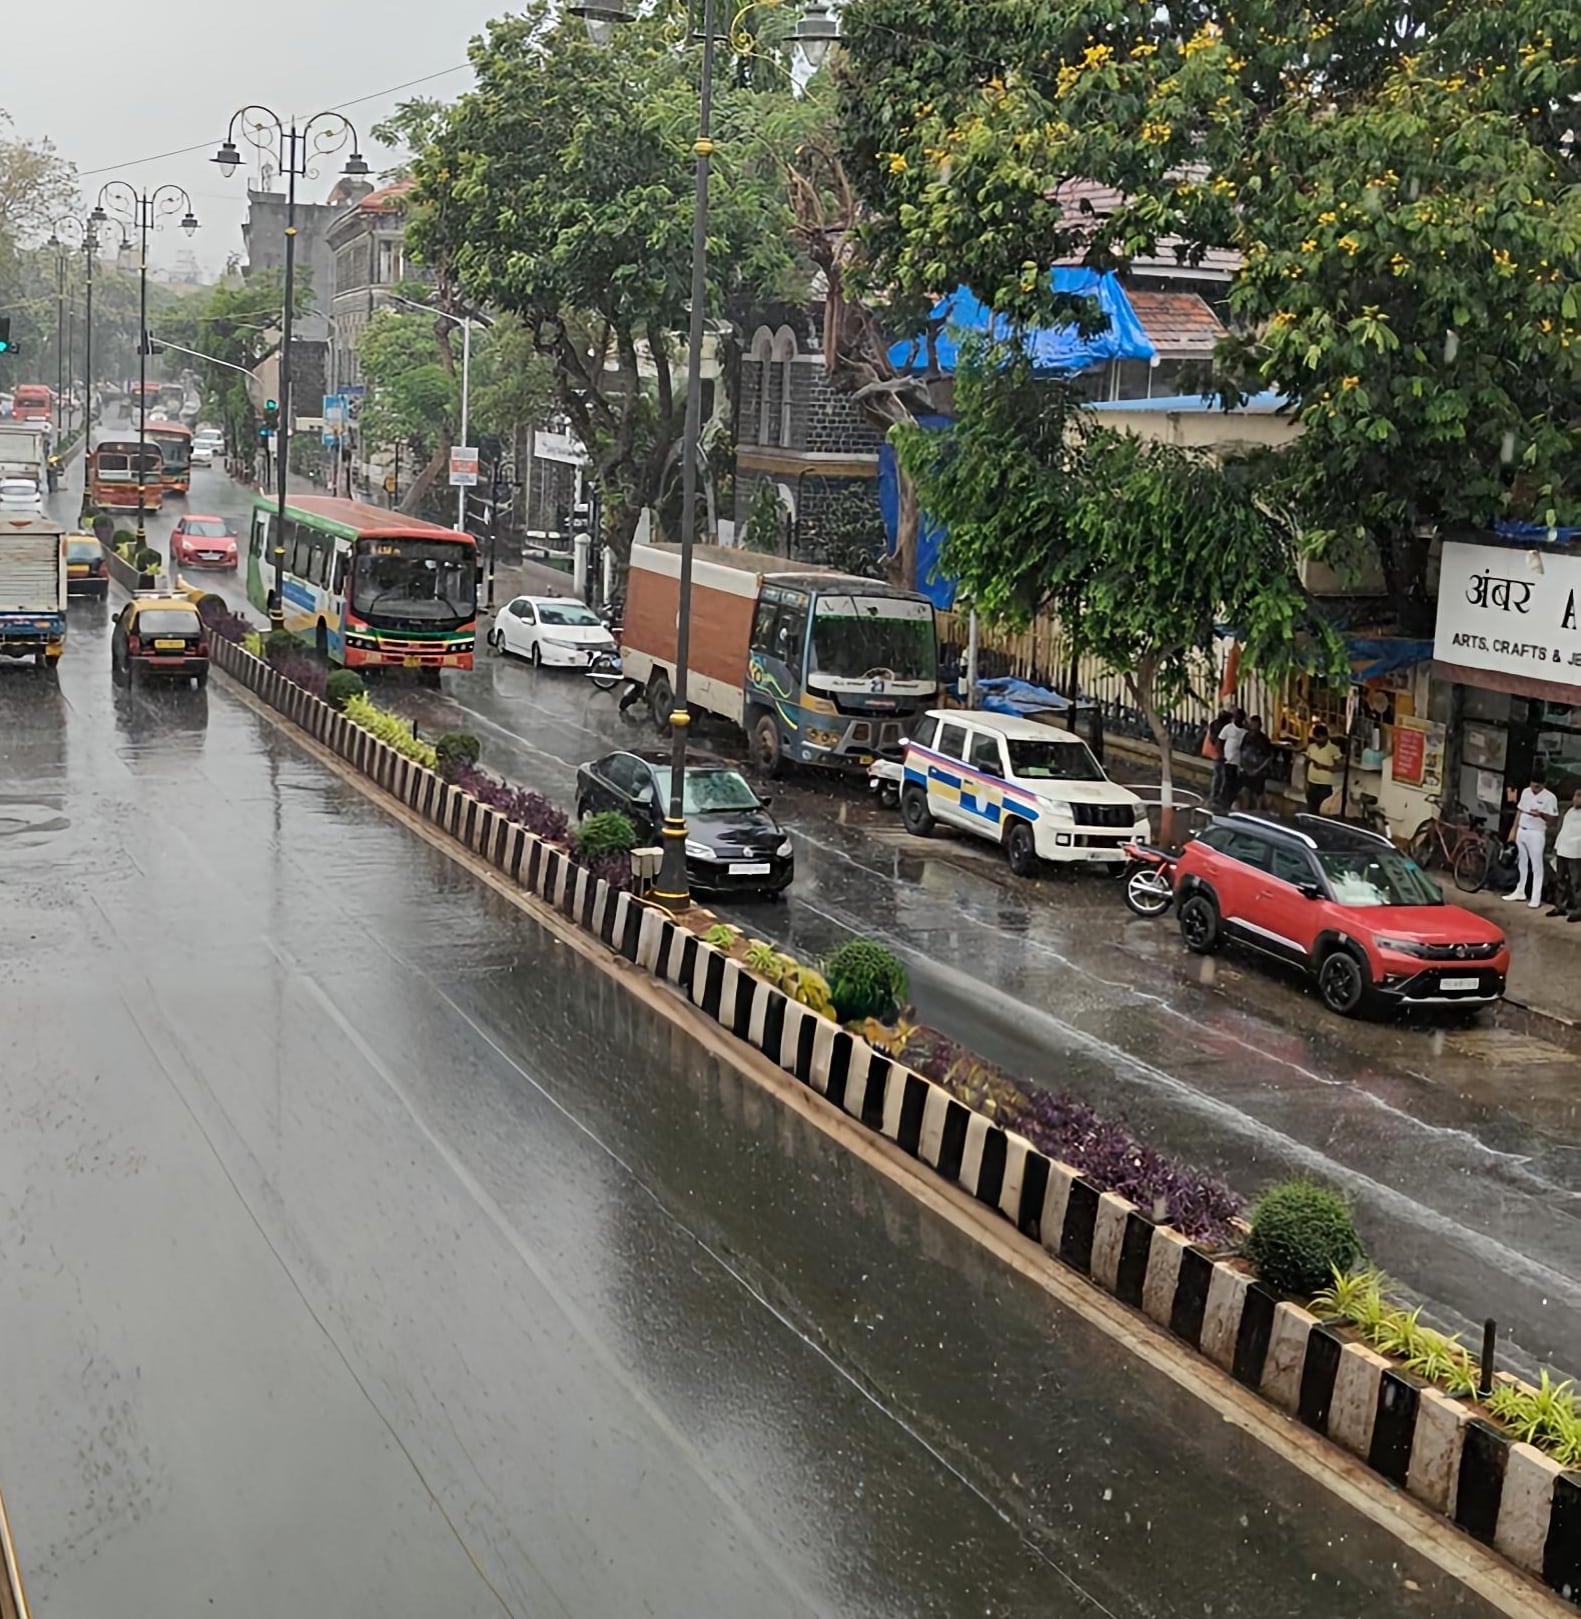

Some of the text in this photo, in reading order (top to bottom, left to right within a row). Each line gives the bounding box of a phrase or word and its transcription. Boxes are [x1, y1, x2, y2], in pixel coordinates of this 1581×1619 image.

[1465, 568, 1536, 614] अंबर
[1561, 588, 1577, 630] A
[1452, 632, 1490, 652] ARTS,
[1493, 639, 1548, 661] CRAFTS
[1552, 649, 1561, 663] &
